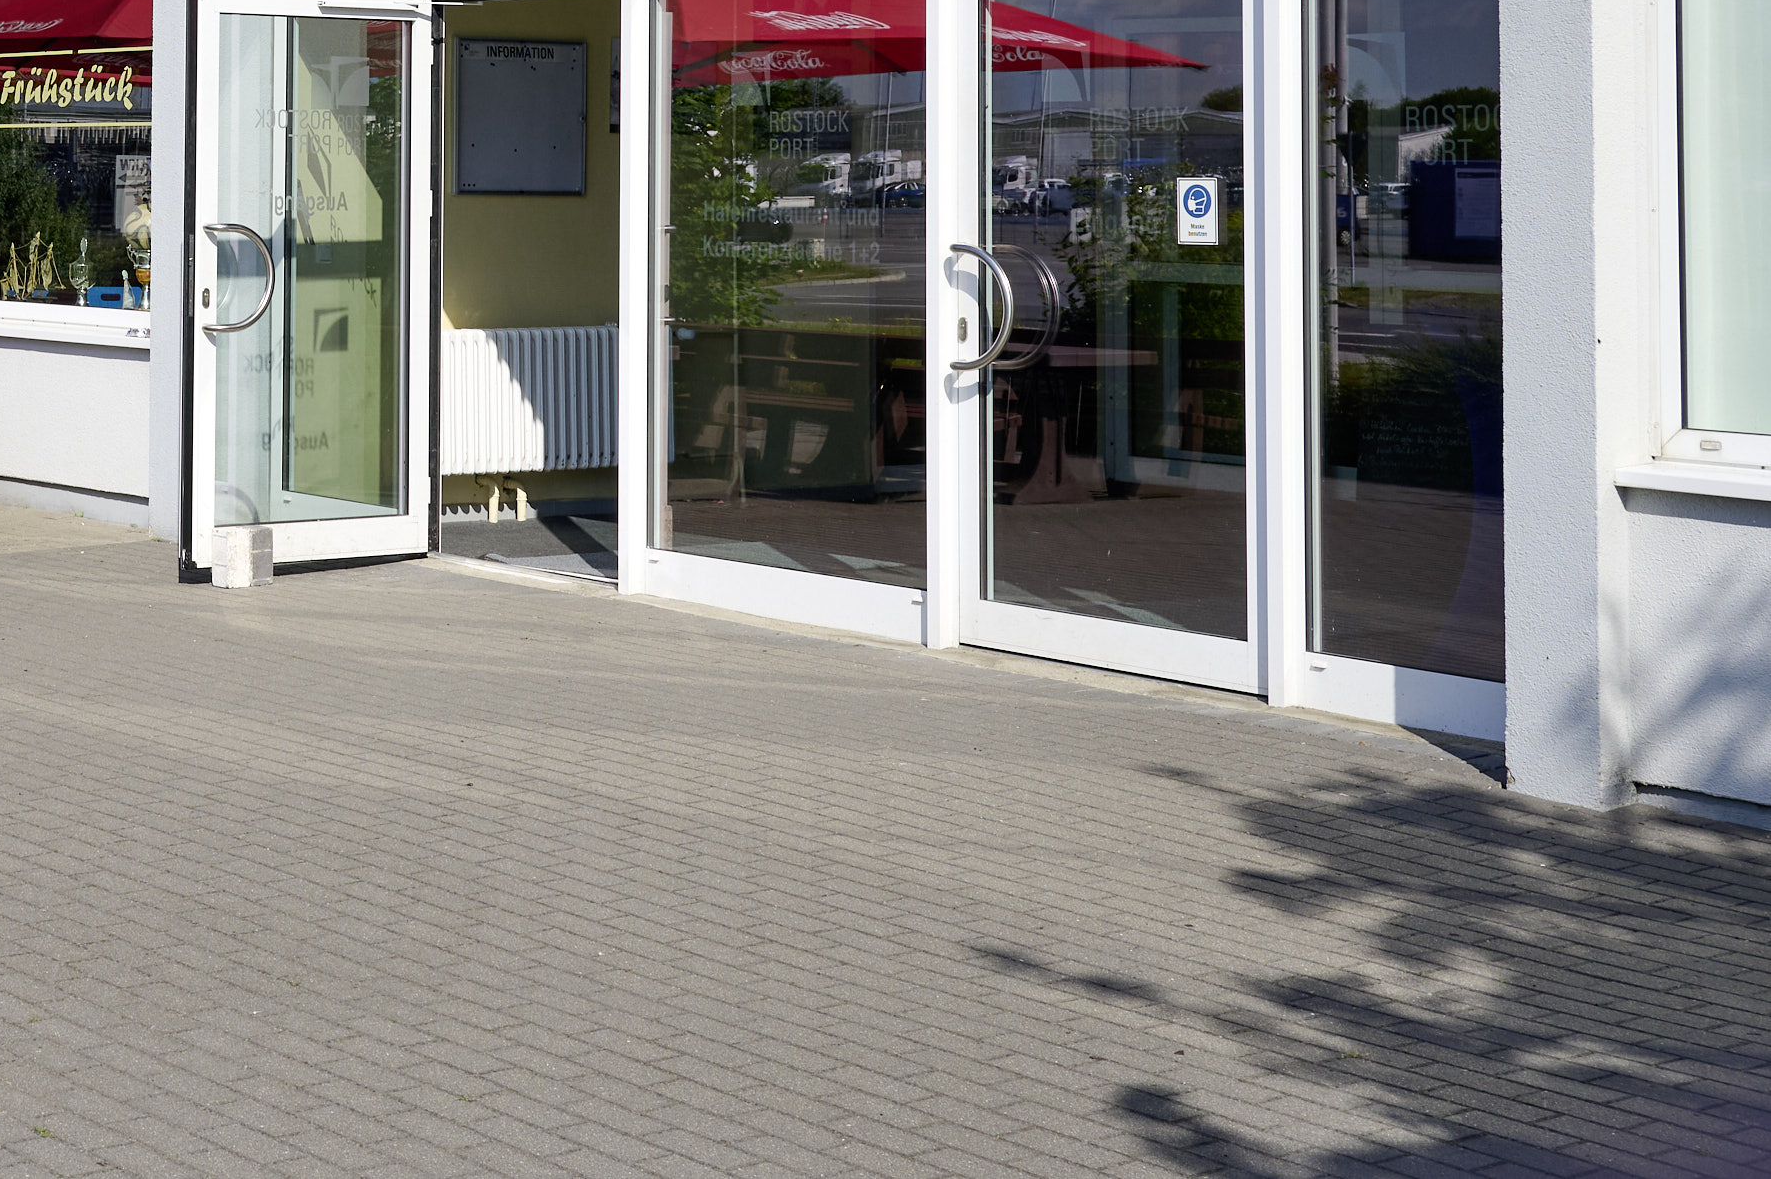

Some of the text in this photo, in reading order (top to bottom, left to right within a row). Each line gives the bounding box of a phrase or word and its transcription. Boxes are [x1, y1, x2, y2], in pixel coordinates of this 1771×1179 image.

[487, 45, 555, 60] INFORMATION
[0, 64, 133, 111] Frühstück
[769, 110, 849, 133] ROSTOCK
[1089, 106, 1188, 132] ROSTOCK
[769, 138, 814, 160] PORT
